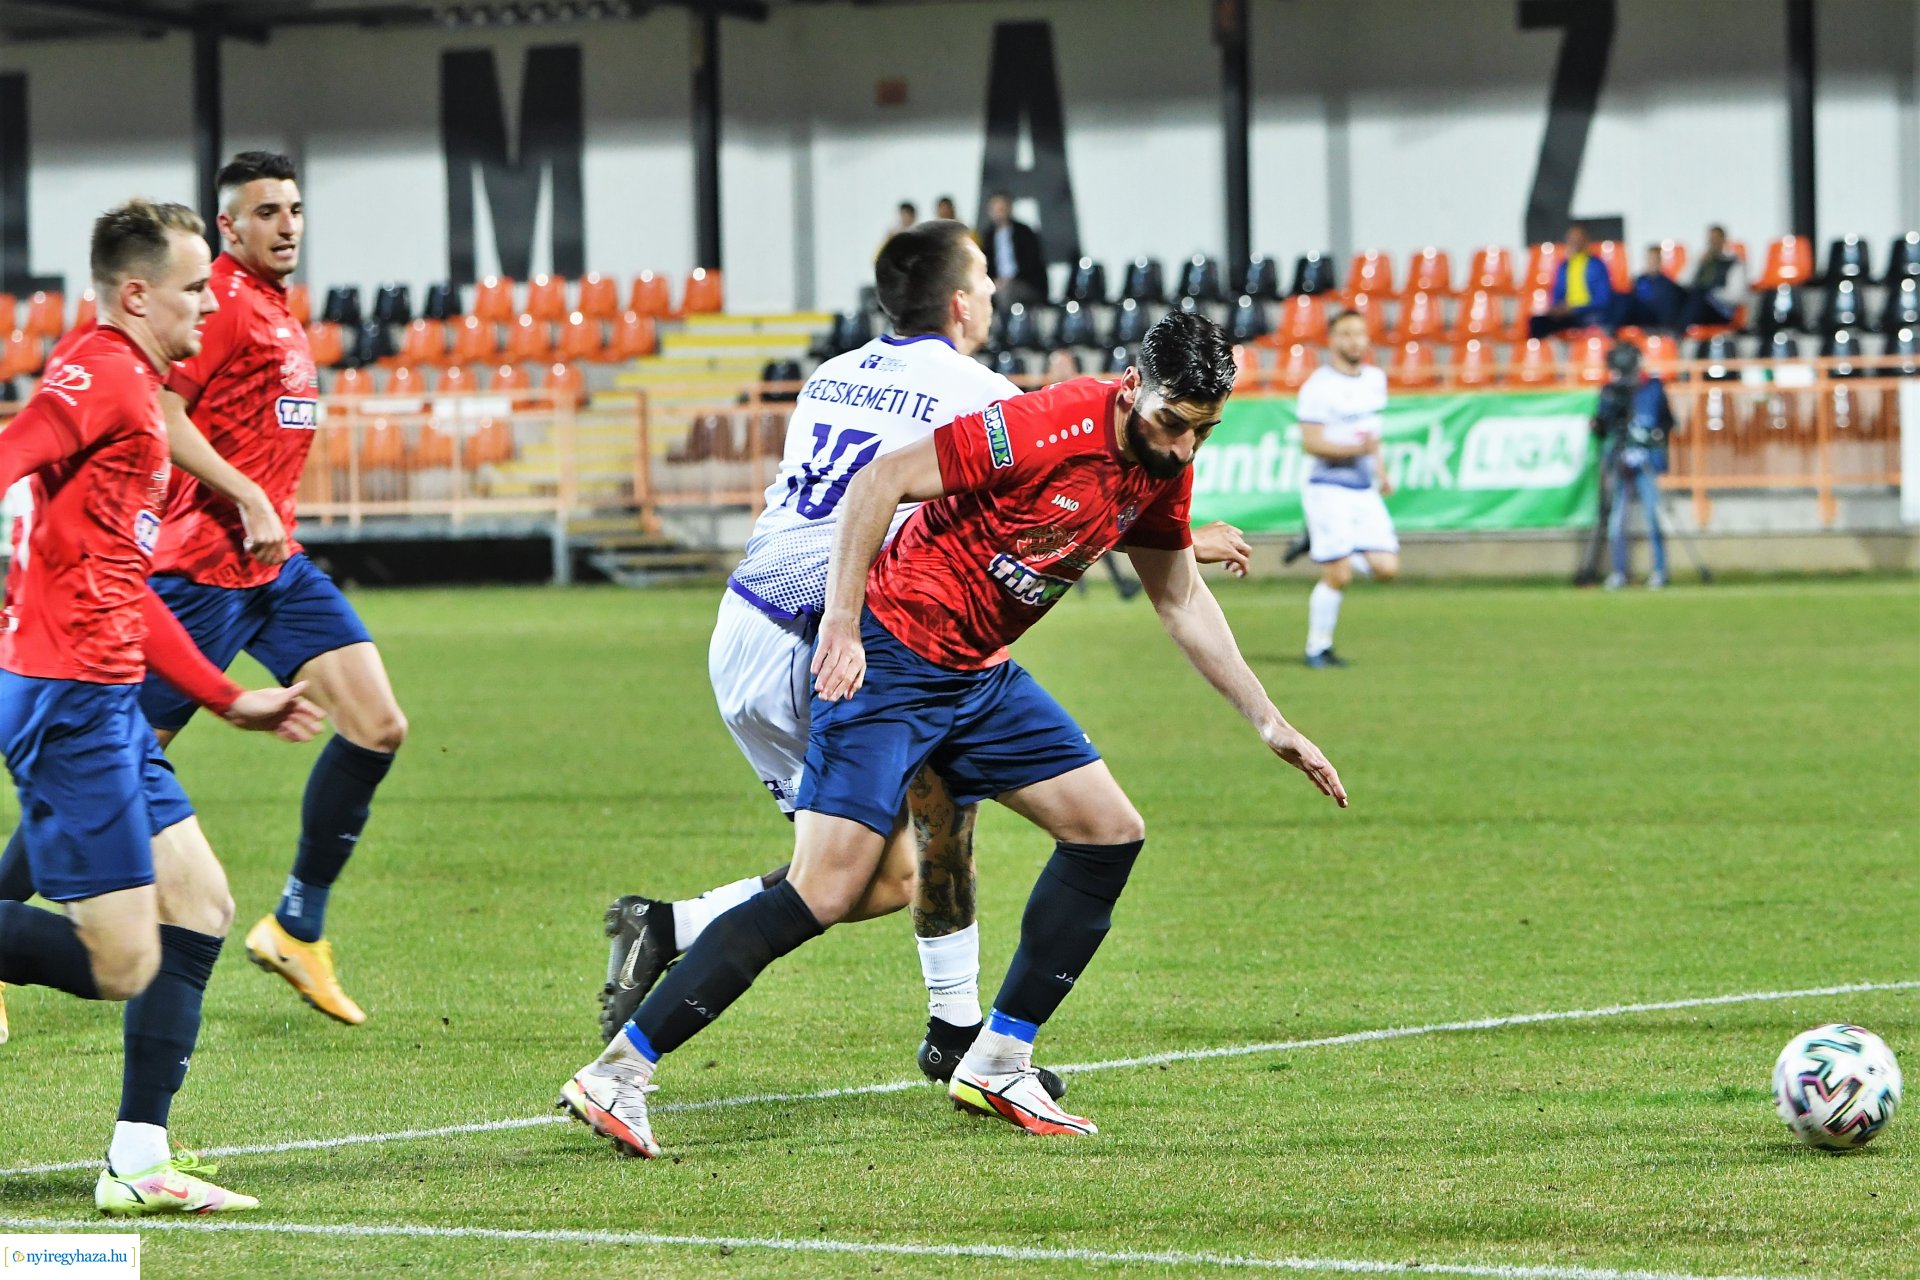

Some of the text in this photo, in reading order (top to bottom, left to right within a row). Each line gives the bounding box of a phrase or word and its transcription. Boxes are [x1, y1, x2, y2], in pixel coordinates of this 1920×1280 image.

[912, 388, 939, 423] TE
[781, 423, 882, 520] 10
[1051, 494, 1080, 512] JAKO
